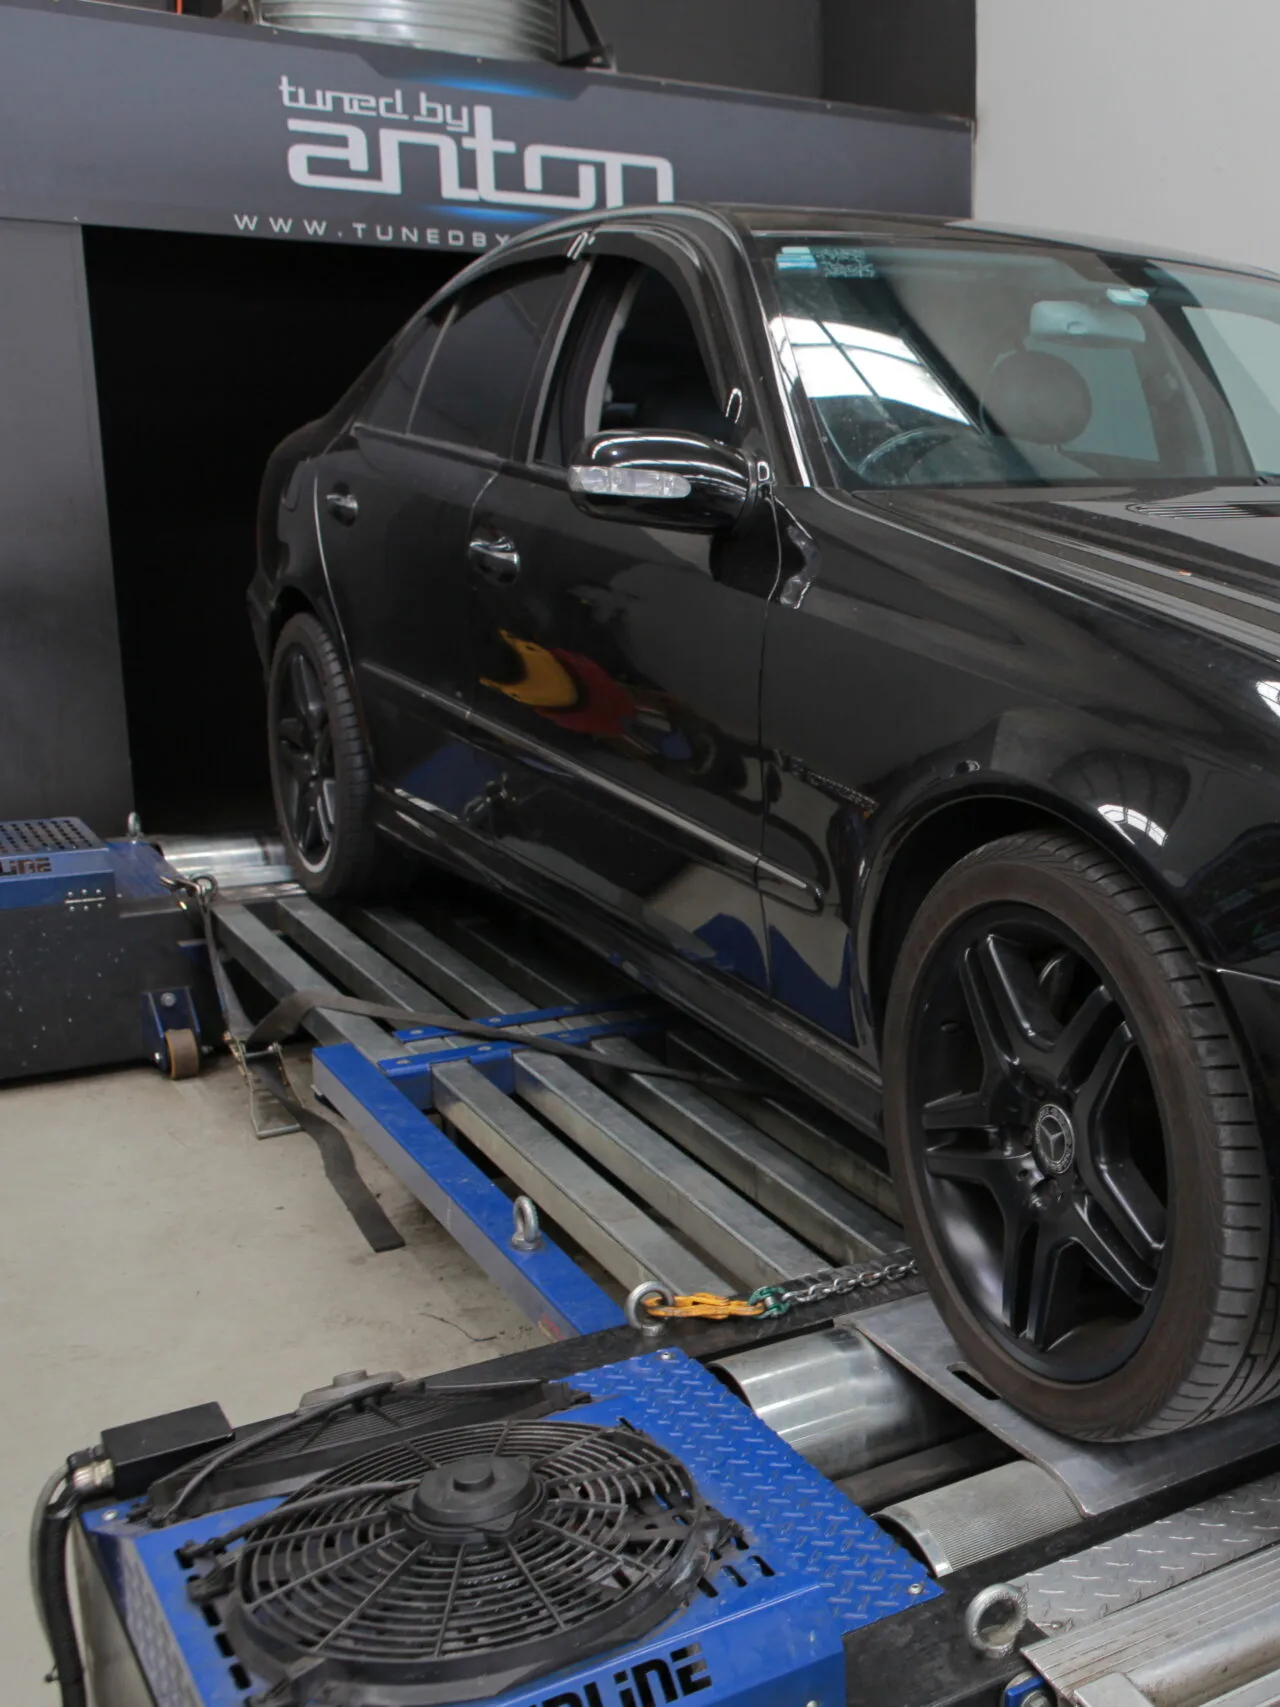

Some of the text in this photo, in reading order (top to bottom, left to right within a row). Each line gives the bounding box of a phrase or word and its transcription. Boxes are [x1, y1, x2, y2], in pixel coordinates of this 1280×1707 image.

[278, 75, 470, 132] tuned by
[287, 105, 675, 209] anton
